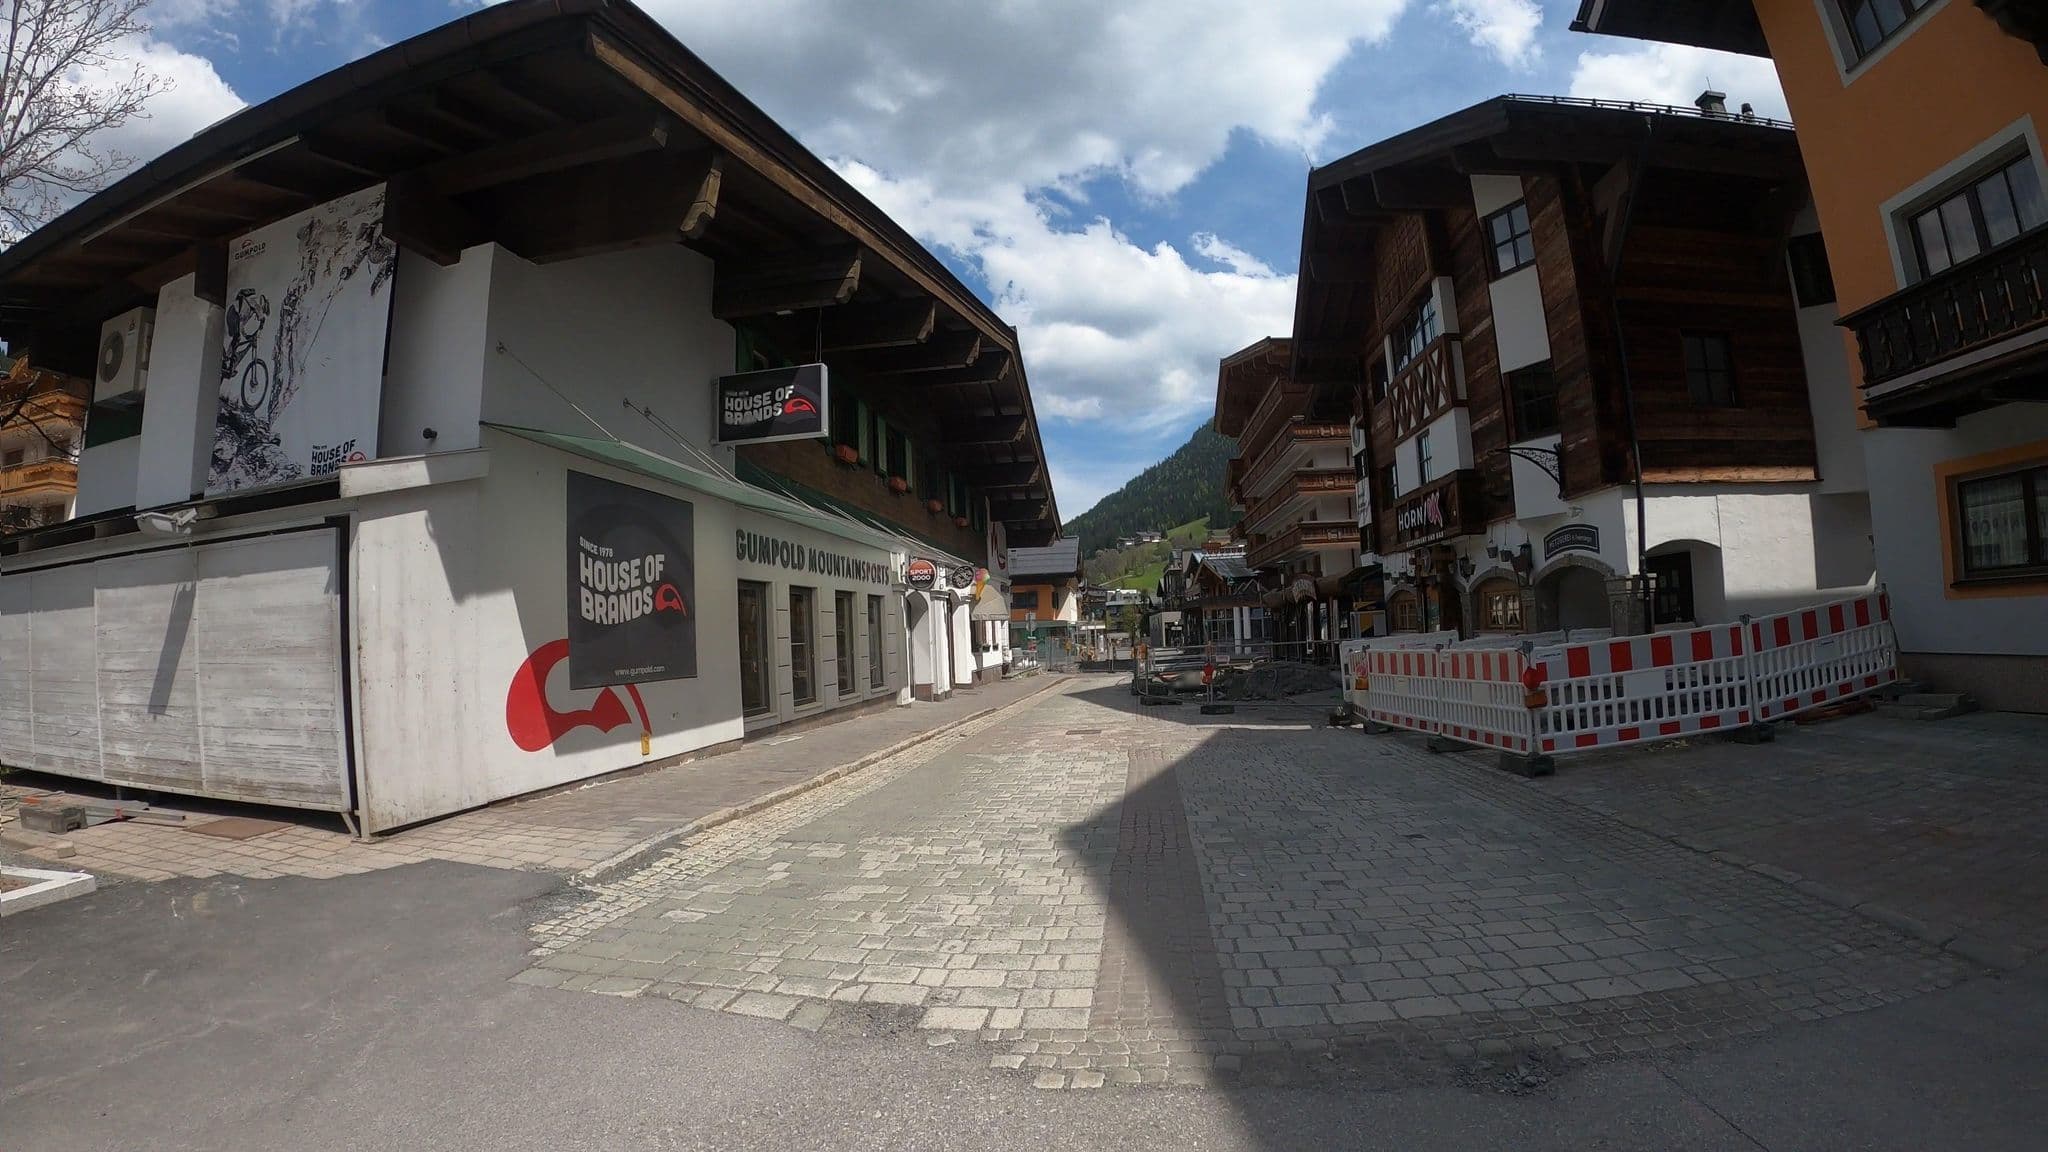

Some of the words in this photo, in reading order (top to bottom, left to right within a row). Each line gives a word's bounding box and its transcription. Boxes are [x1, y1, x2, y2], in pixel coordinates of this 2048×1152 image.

[234, 242, 266, 260] GUMPOLD
[725, 391, 772, 412] HOUSE
[775, 385, 794, 399] OF
[724, 402, 782, 425] BRANDS
[311, 445, 341, 464] HOUSE
[343, 439, 356, 454] OF
[579, 536, 599, 555] SINCE
[599, 546, 614, 558] 1978
[735, 528, 805, 571] GUMPOLD
[808, 548, 889, 586] MOUNTAINSPORTS
[579, 551, 641, 593] HOUSE
[644, 554, 665, 583] OF
[580, 586, 653, 625] BRANDS
[614, 665, 666, 677] www.gumpold.com
